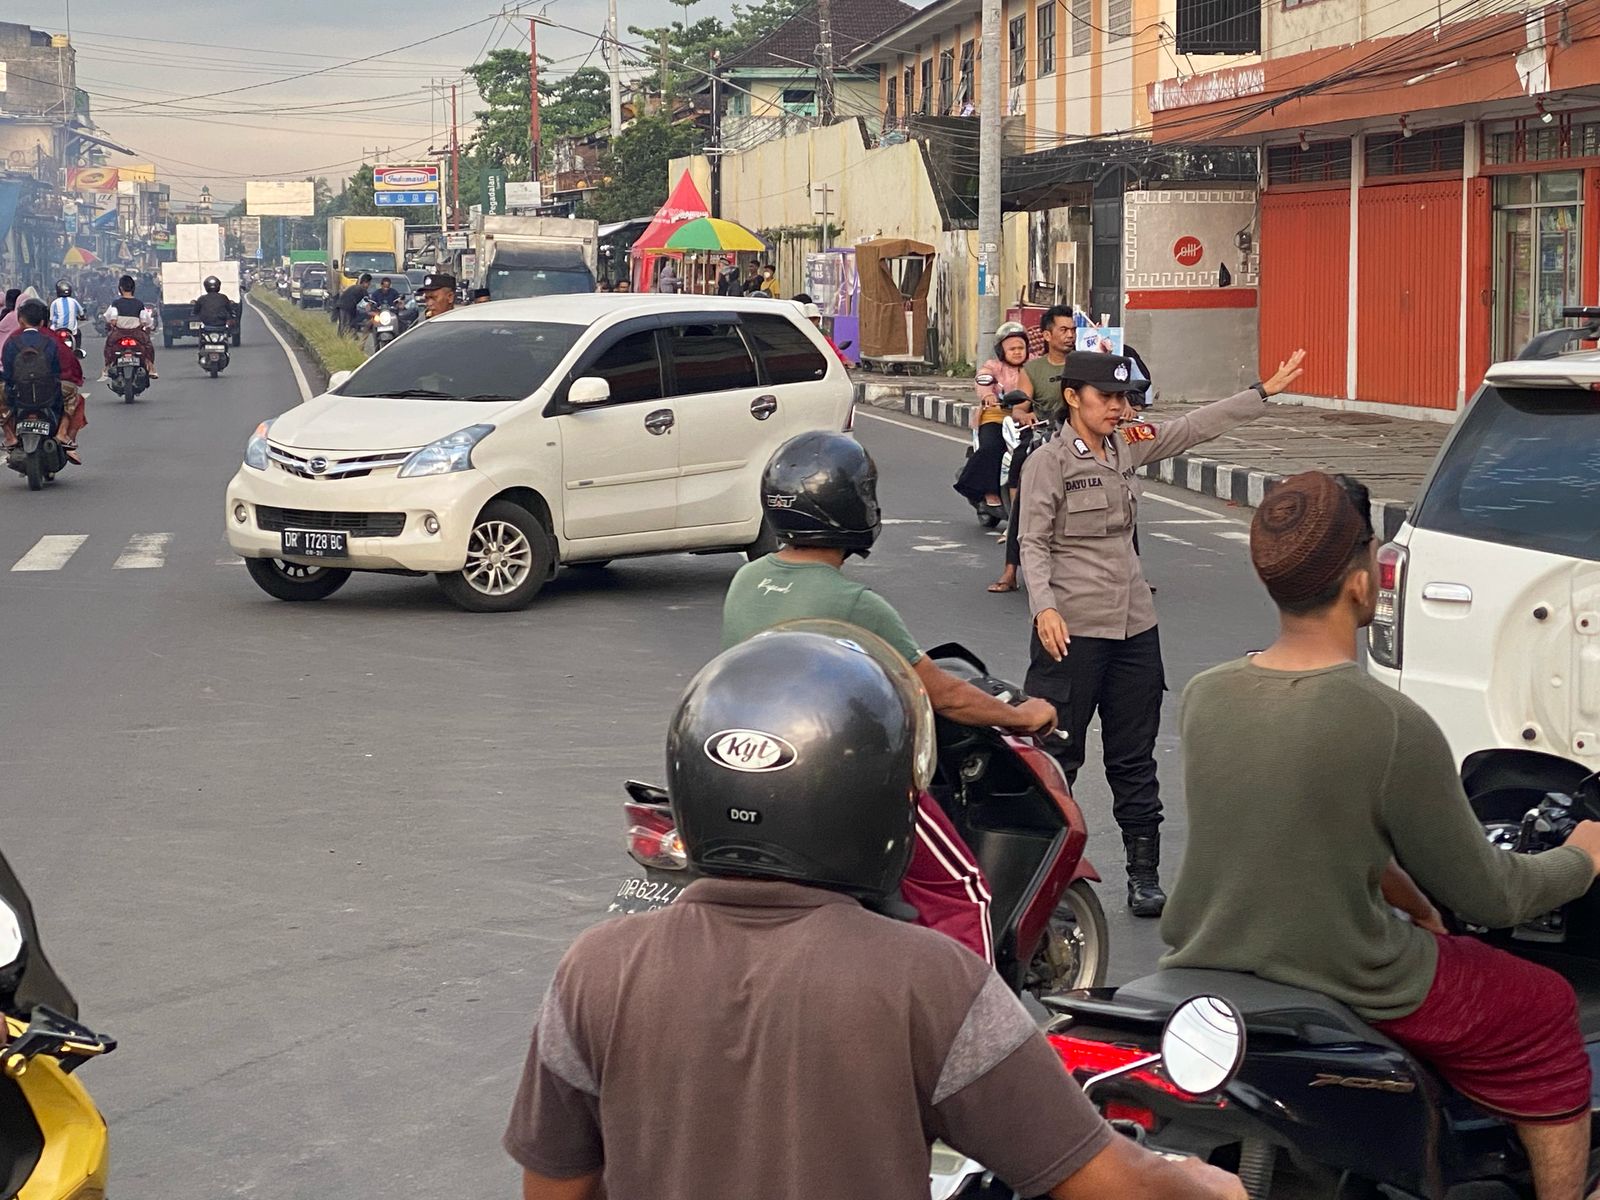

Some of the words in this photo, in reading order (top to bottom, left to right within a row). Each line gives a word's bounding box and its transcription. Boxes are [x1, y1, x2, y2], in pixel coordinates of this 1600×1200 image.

[1065, 480, 1087, 491] DAYU
[1087, 477, 1103, 487] LEA
[285, 532, 298, 548] DR
[305, 533, 327, 549] 1728
[330, 534, 343, 550] BC
[725, 736, 773, 762] Kyt
[730, 808, 757, 822] DOT
